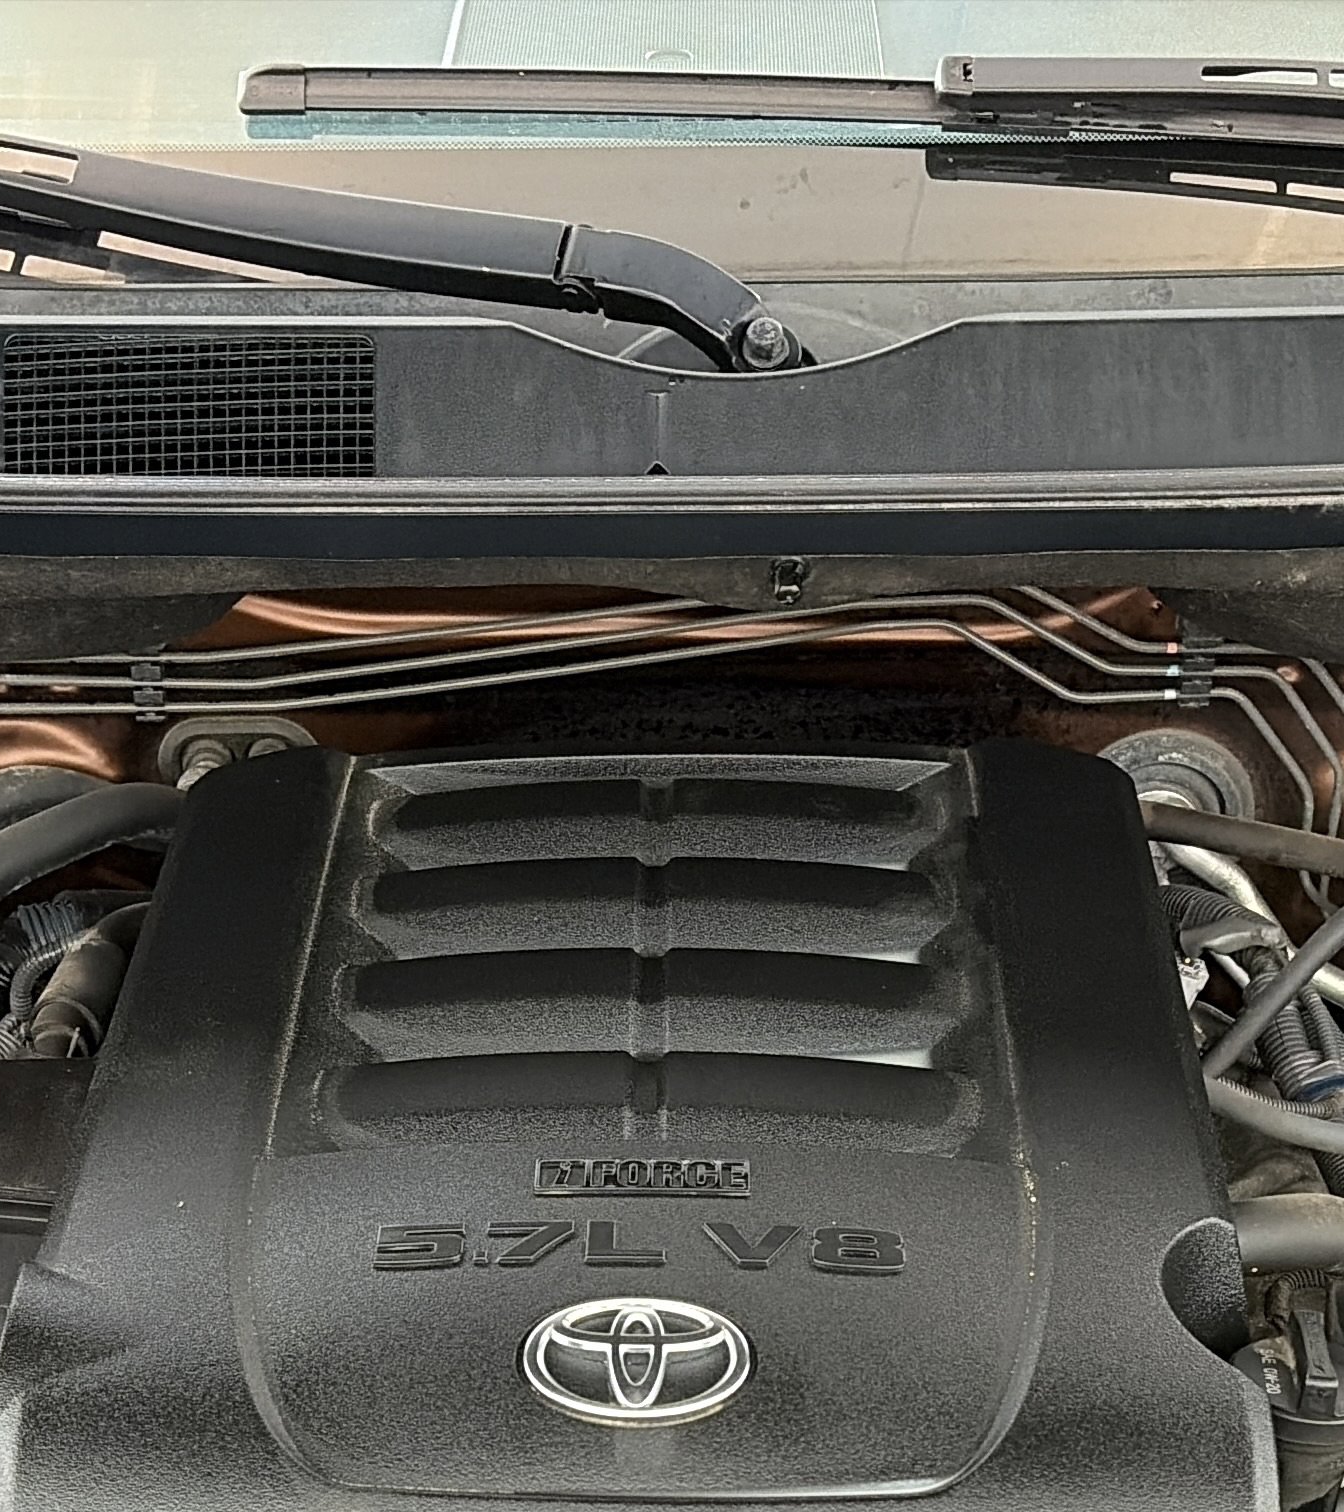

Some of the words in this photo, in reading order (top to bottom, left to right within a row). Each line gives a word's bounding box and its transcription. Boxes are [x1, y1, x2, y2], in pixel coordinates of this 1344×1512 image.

[587, 1159, 751, 1190] FORCE
[372, 1219, 668, 1270] 5.7L
[700, 1221, 909, 1274] V8
